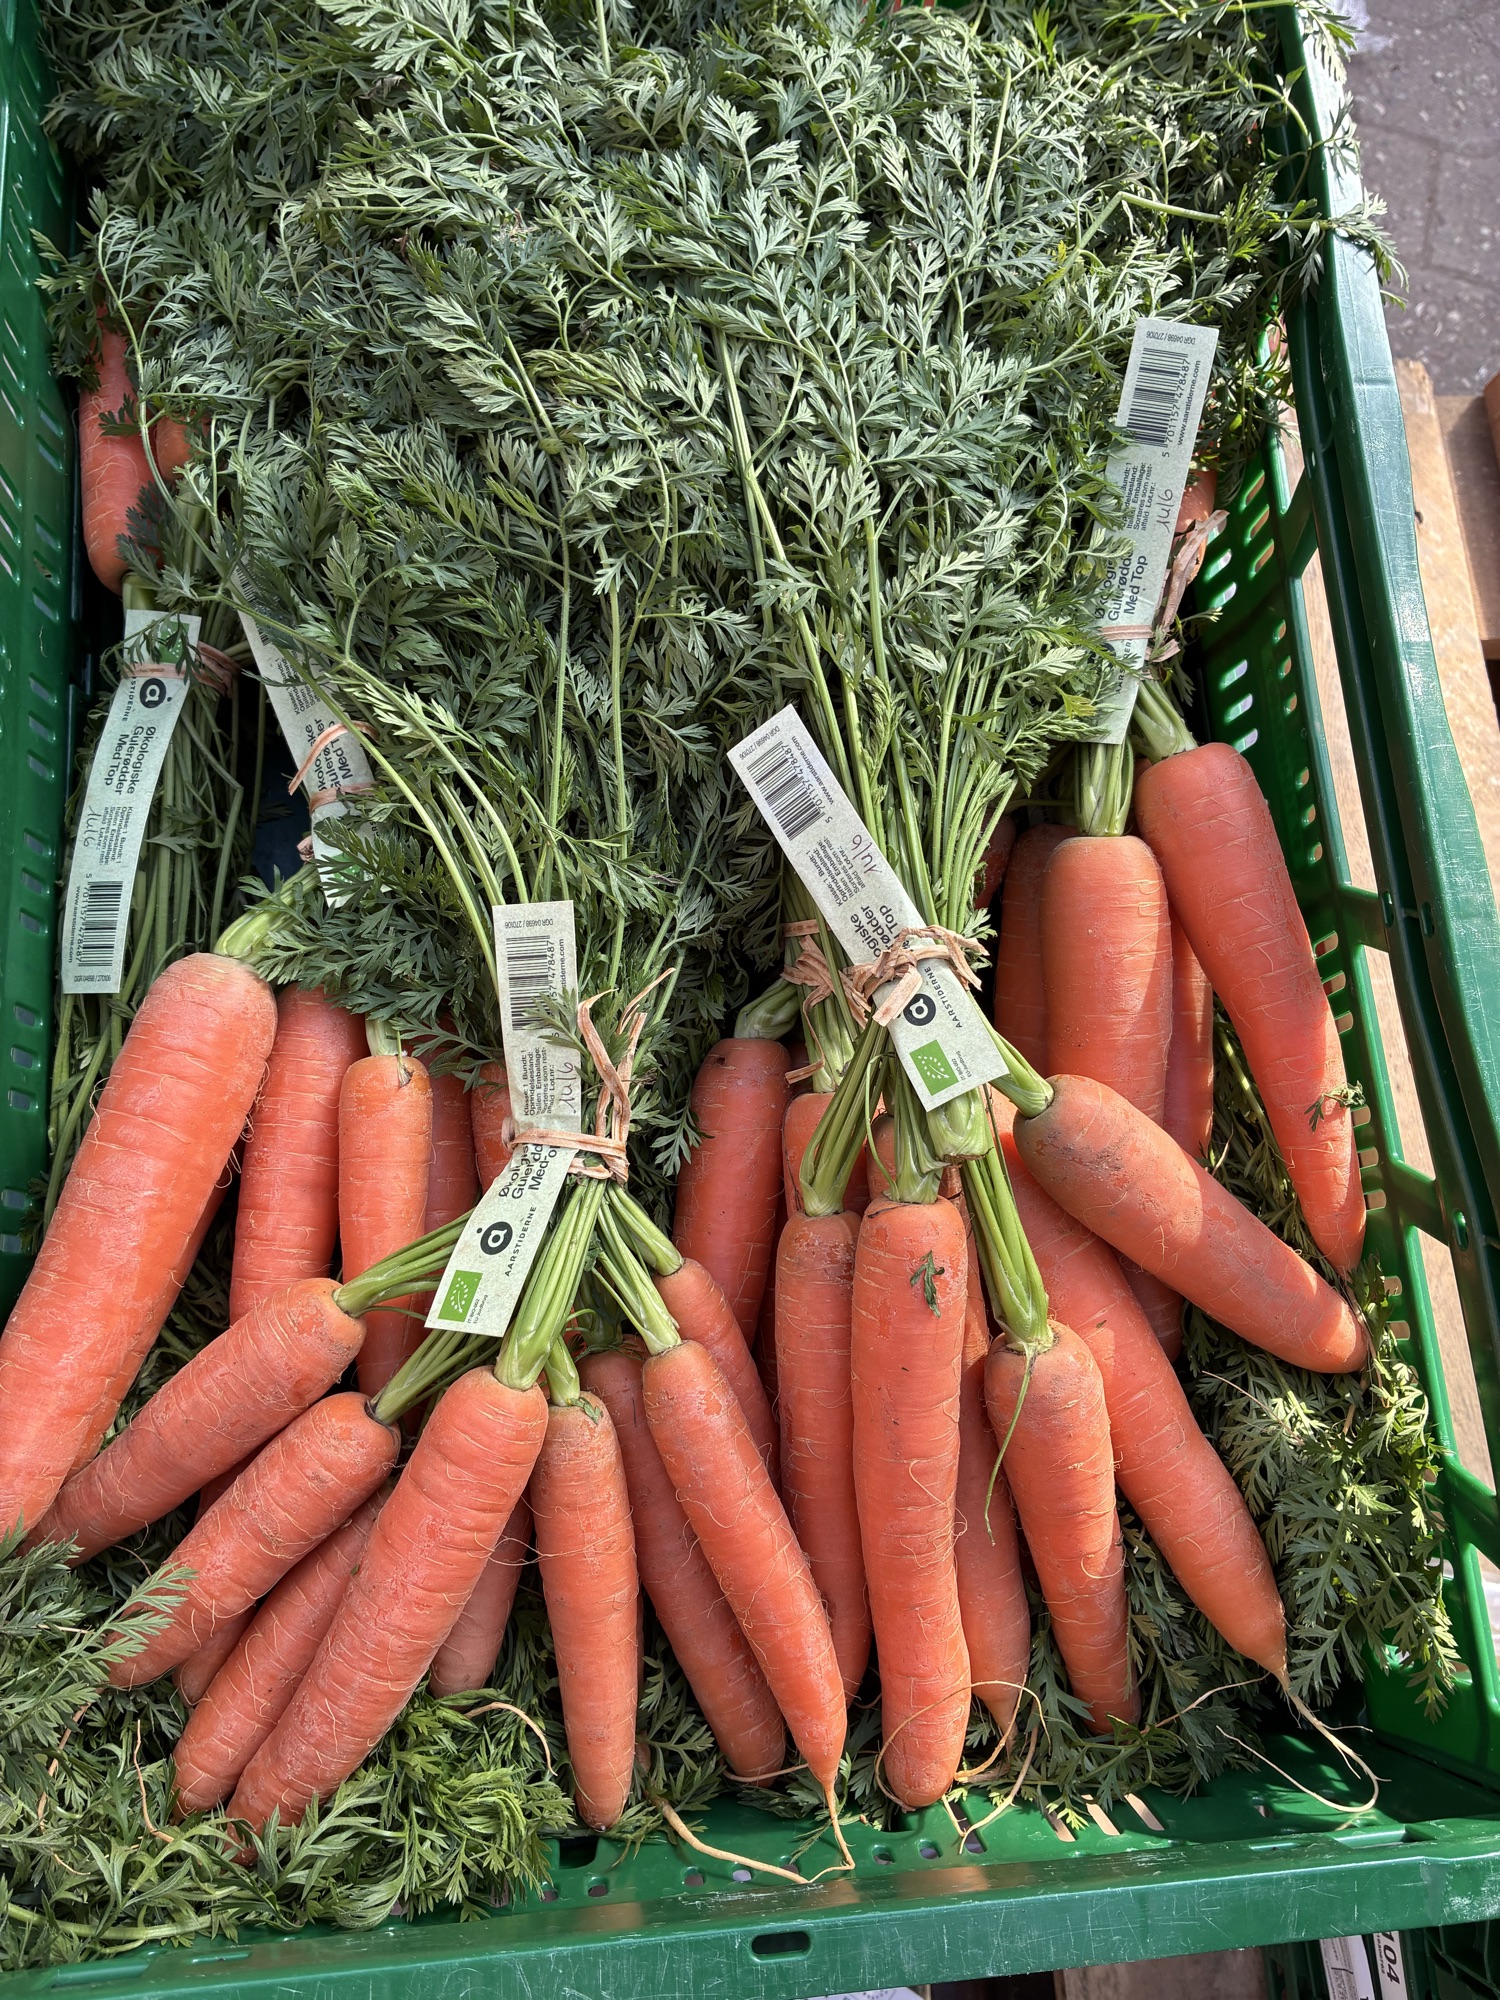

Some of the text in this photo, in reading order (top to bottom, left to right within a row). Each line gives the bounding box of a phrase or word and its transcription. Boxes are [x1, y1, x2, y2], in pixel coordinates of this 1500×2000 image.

[1184, 336, 1195, 345] DGR
[1165, 404, 1180, 443] 701157
[1176, 359, 1191, 398] 478487
[1178, 360, 1200, 445] www.aarstiderne.com
[1132, 462, 1146, 503] Emballage:
[1133, 499, 1145, 530] Sorteres
[1124, 555, 1148, 614] Med Top
[769, 726, 780, 736] DGR
[104, 734, 129, 785] Med Top
[115, 726, 144, 795] Gulerødder
[127, 727, 156, 794] Økologiske
[335, 748, 353, 780] Med
[781, 744, 803, 776] 478487
[792, 736, 834, 804] www.aarstiderne.com
[802, 780, 825, 813] 701157
[807, 854, 825, 876] Bundt:
[811, 847, 849, 902] Oprindelsesland:
[815, 838, 855, 898] Italien Emballage:
[821, 835, 861, 893] Sorteres som rest-
[851, 869, 866, 889] affald
[80, 887, 89, 921] 701157
[824, 881, 843, 906] Klasse:
[880, 905, 898, 934] Top
[76, 926, 86, 963] 478487
[547, 940, 556, 979] 478487
[924, 966, 962, 1028] AARSTIDERNE
[528, 1160, 549, 1191] Med
[505, 1206, 536, 1277] AARSTIDERNE
